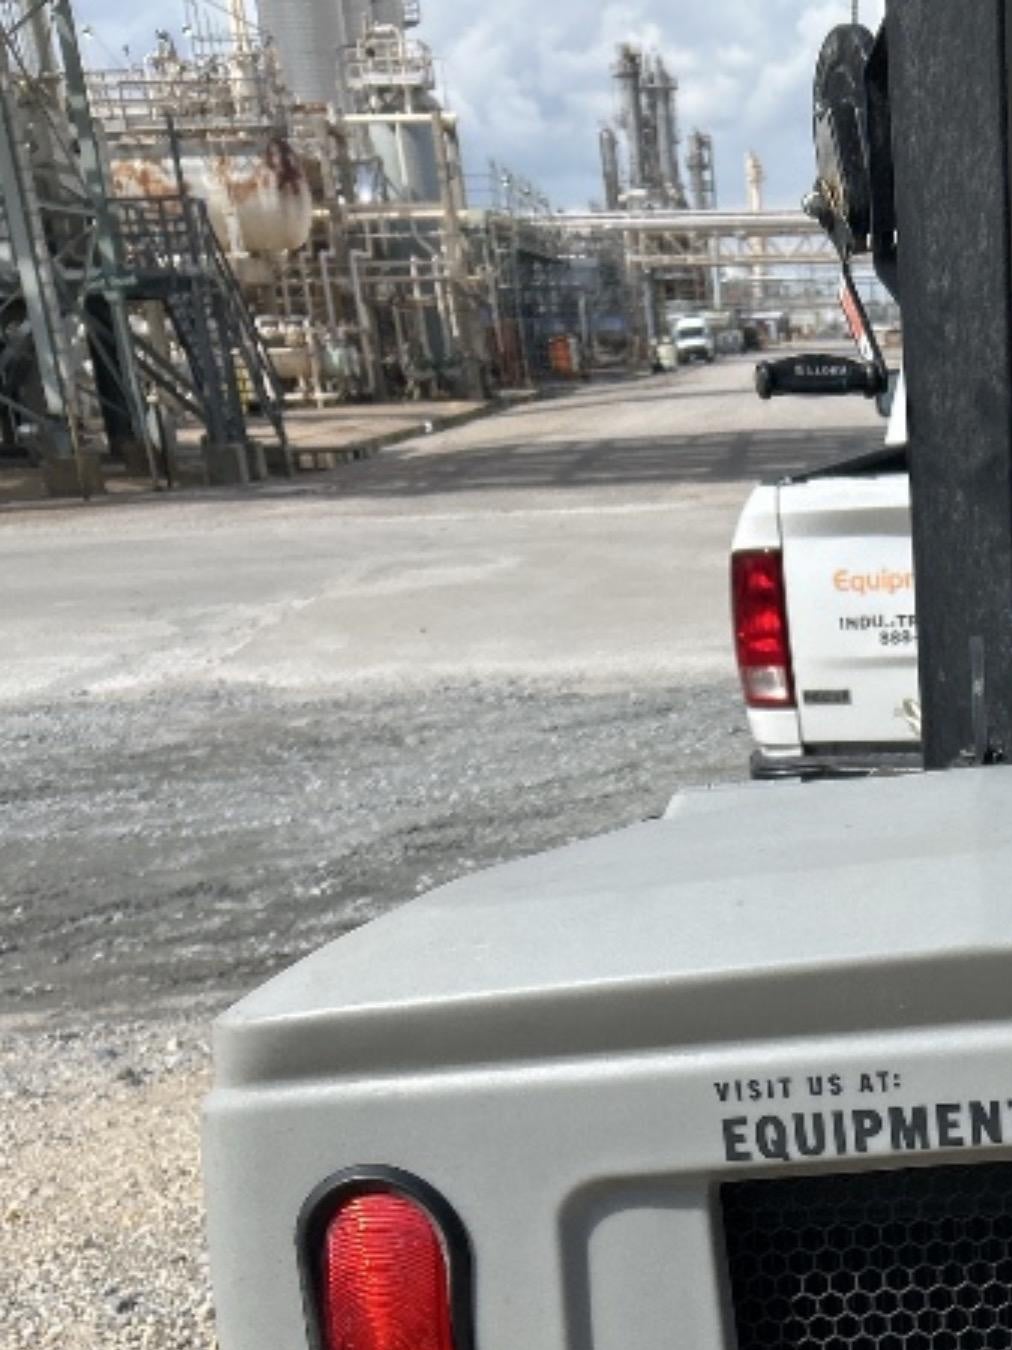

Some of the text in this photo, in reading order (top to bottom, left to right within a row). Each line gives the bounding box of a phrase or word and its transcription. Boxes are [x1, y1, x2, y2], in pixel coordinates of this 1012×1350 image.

[714, 1071, 901, 1101] VISIT US AT:
